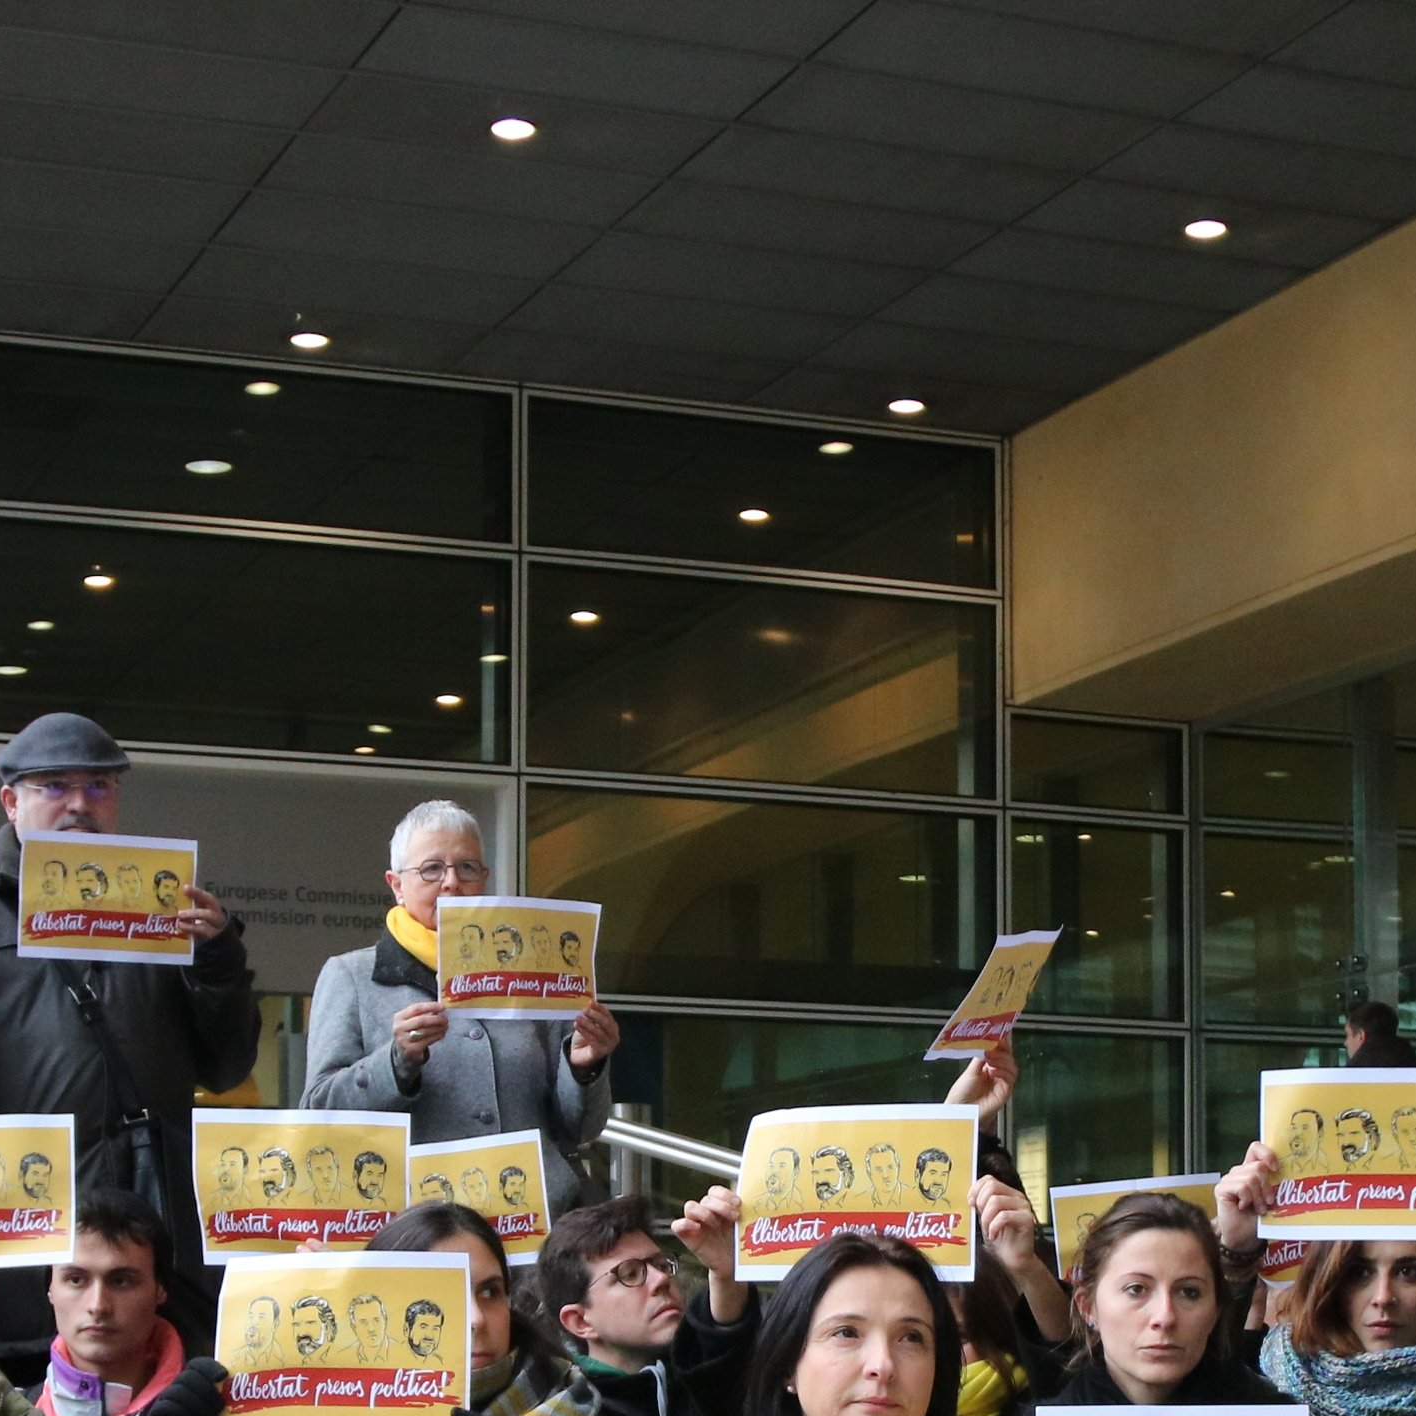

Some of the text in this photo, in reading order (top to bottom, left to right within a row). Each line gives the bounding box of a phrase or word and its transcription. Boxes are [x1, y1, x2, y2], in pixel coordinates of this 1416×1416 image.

[229, 908, 316, 925] mmission
[1275, 1178, 1353, 1206] llibertat
[213, 1210, 274, 1233] llibertat
[750, 1216, 827, 1245] llibertat
[230, 1371, 310, 1401] llibertat
[314, 1378, 365, 1407] presos
